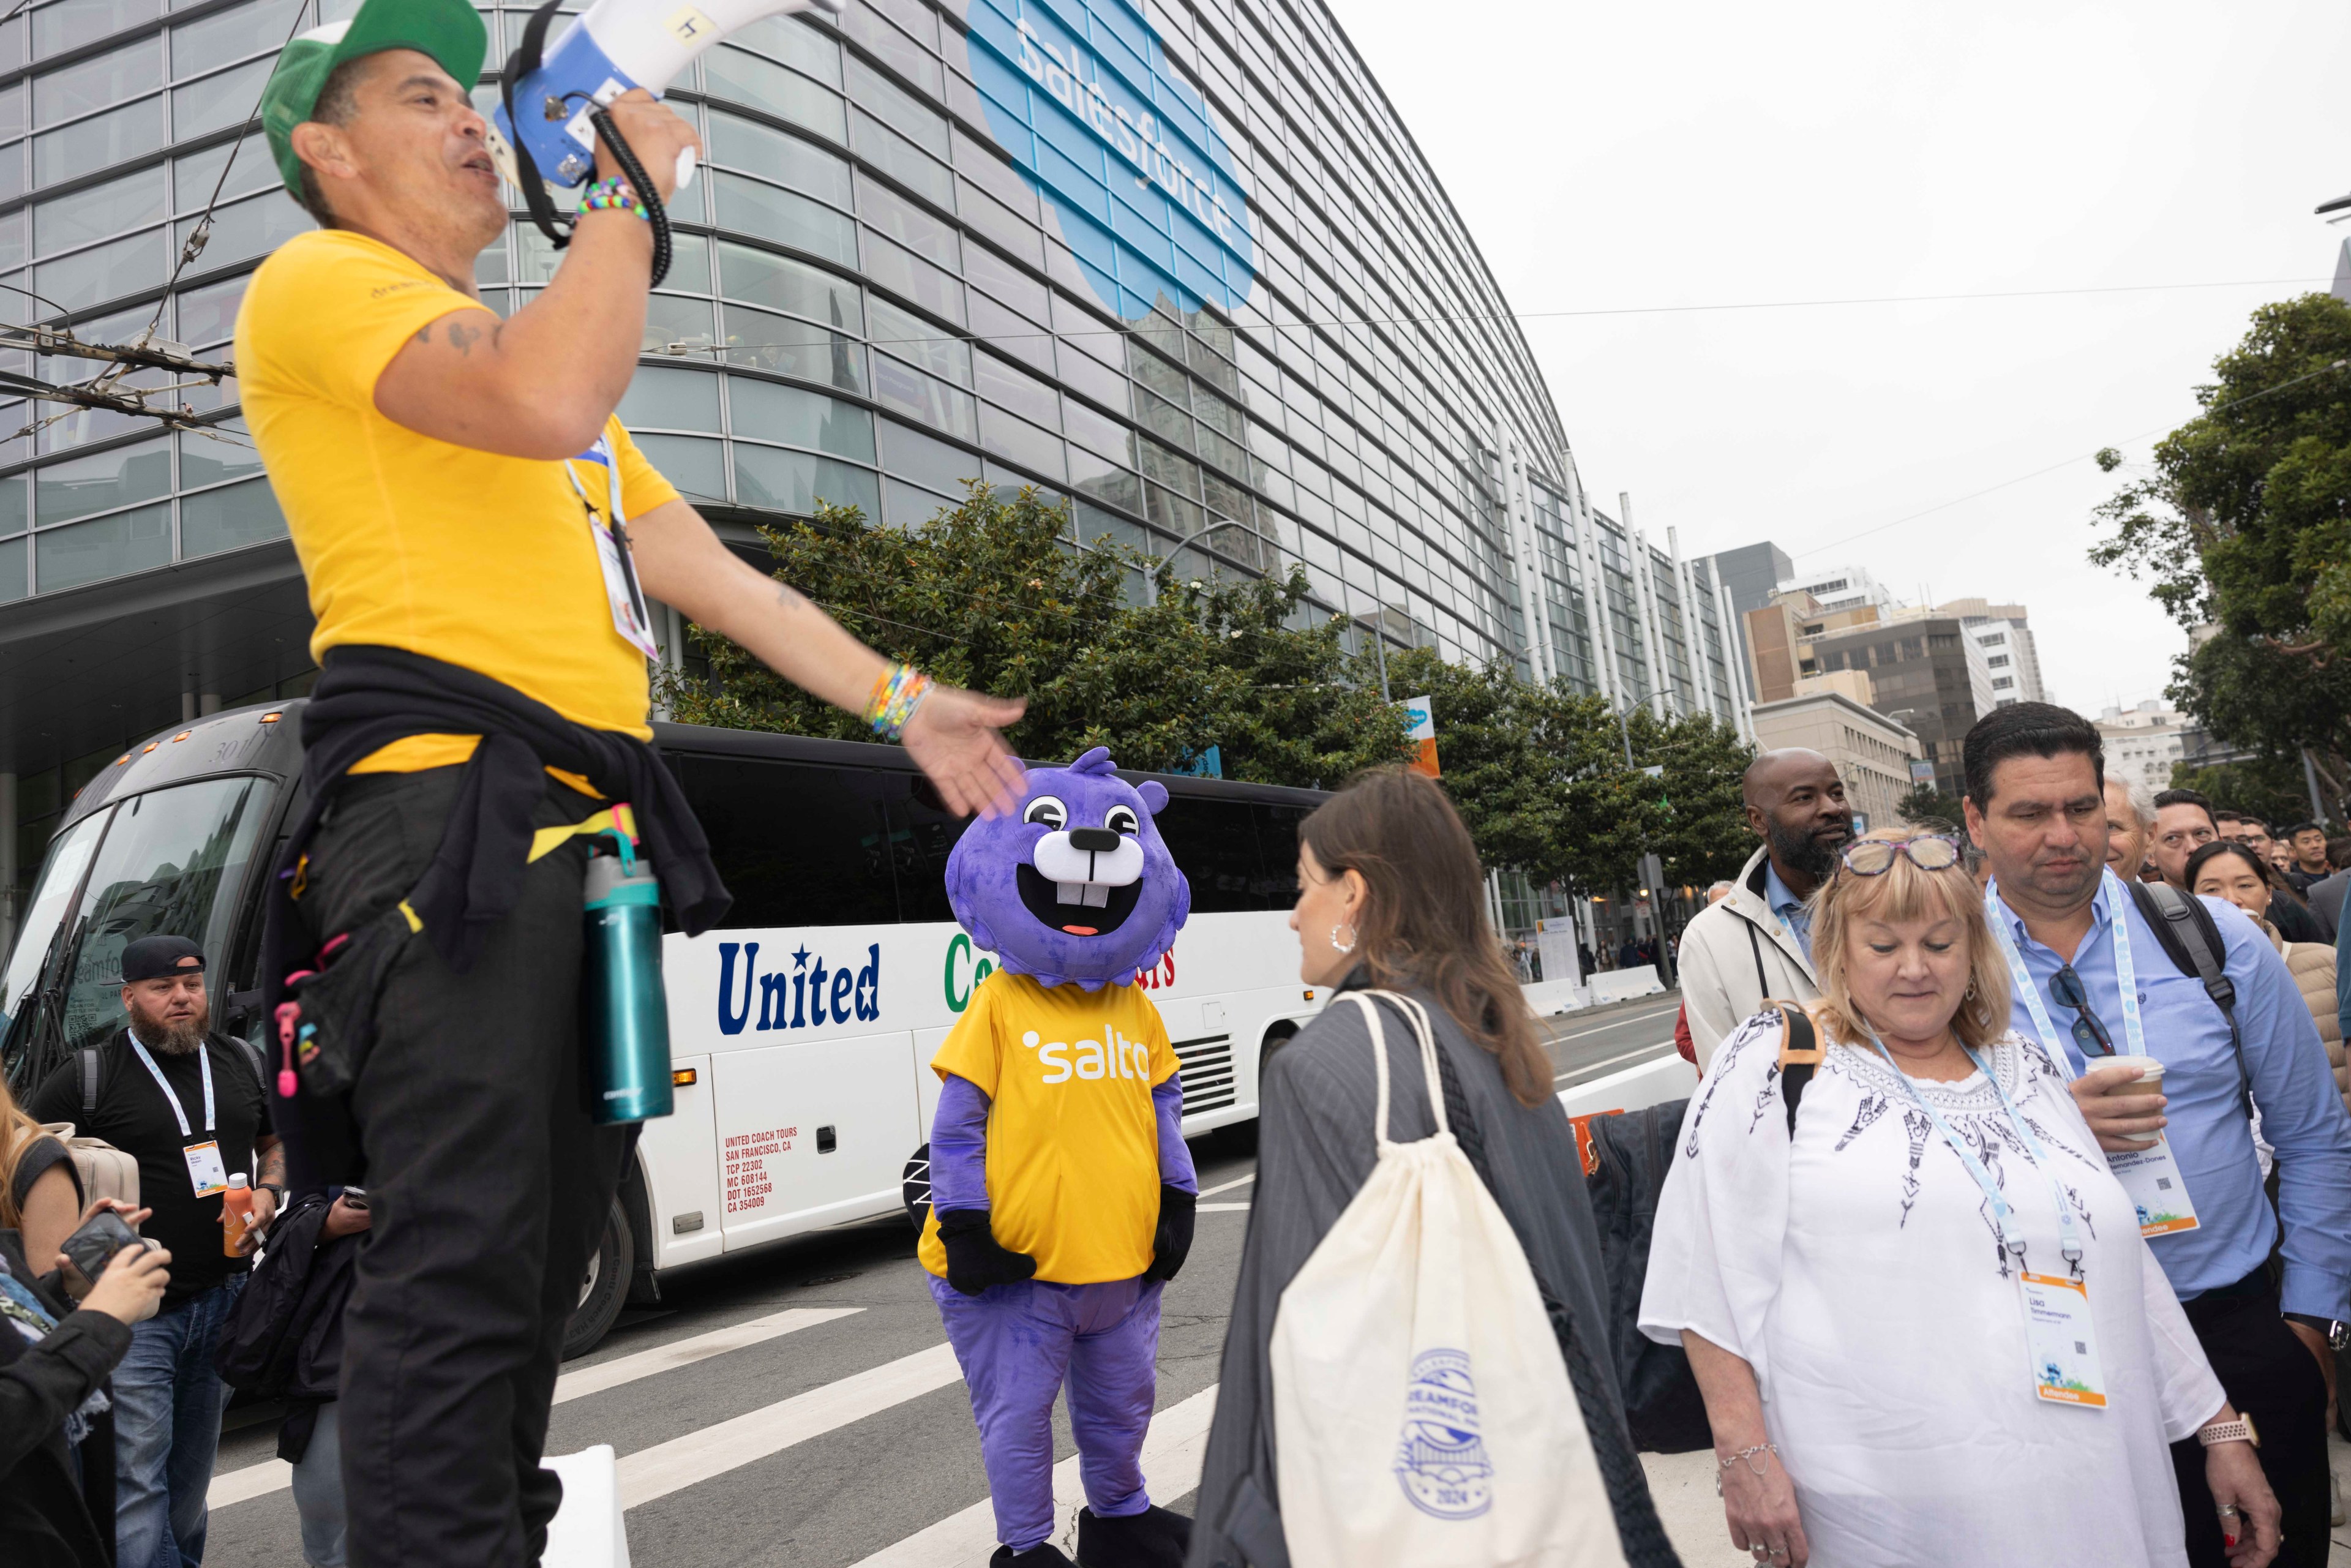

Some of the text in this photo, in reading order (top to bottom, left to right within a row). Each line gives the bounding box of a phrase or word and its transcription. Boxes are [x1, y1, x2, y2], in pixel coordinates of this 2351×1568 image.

[1016, 18, 1233, 246] salesforce
[718, 942, 880, 1035] United
[726, 1127, 797, 1148] UNITED COACH TOURS
[726, 1141, 791, 1161] SAN FRANCISCO, CA
[2106, 1152, 2139, 1162] Antonio
[726, 1159, 763, 1175] TCP 22302
[727, 1171, 767, 1188] MC 608144
[727, 1182, 772, 1201] DOT 1652568
[727, 1196, 765, 1213] CA 354009
[2141, 1225, 2169, 1234] endee
[2029, 1297, 2045, 1307] Lisa
[2044, 1387, 2080, 1401] Attendee
[1436, 1488, 1468, 1505] 2024
